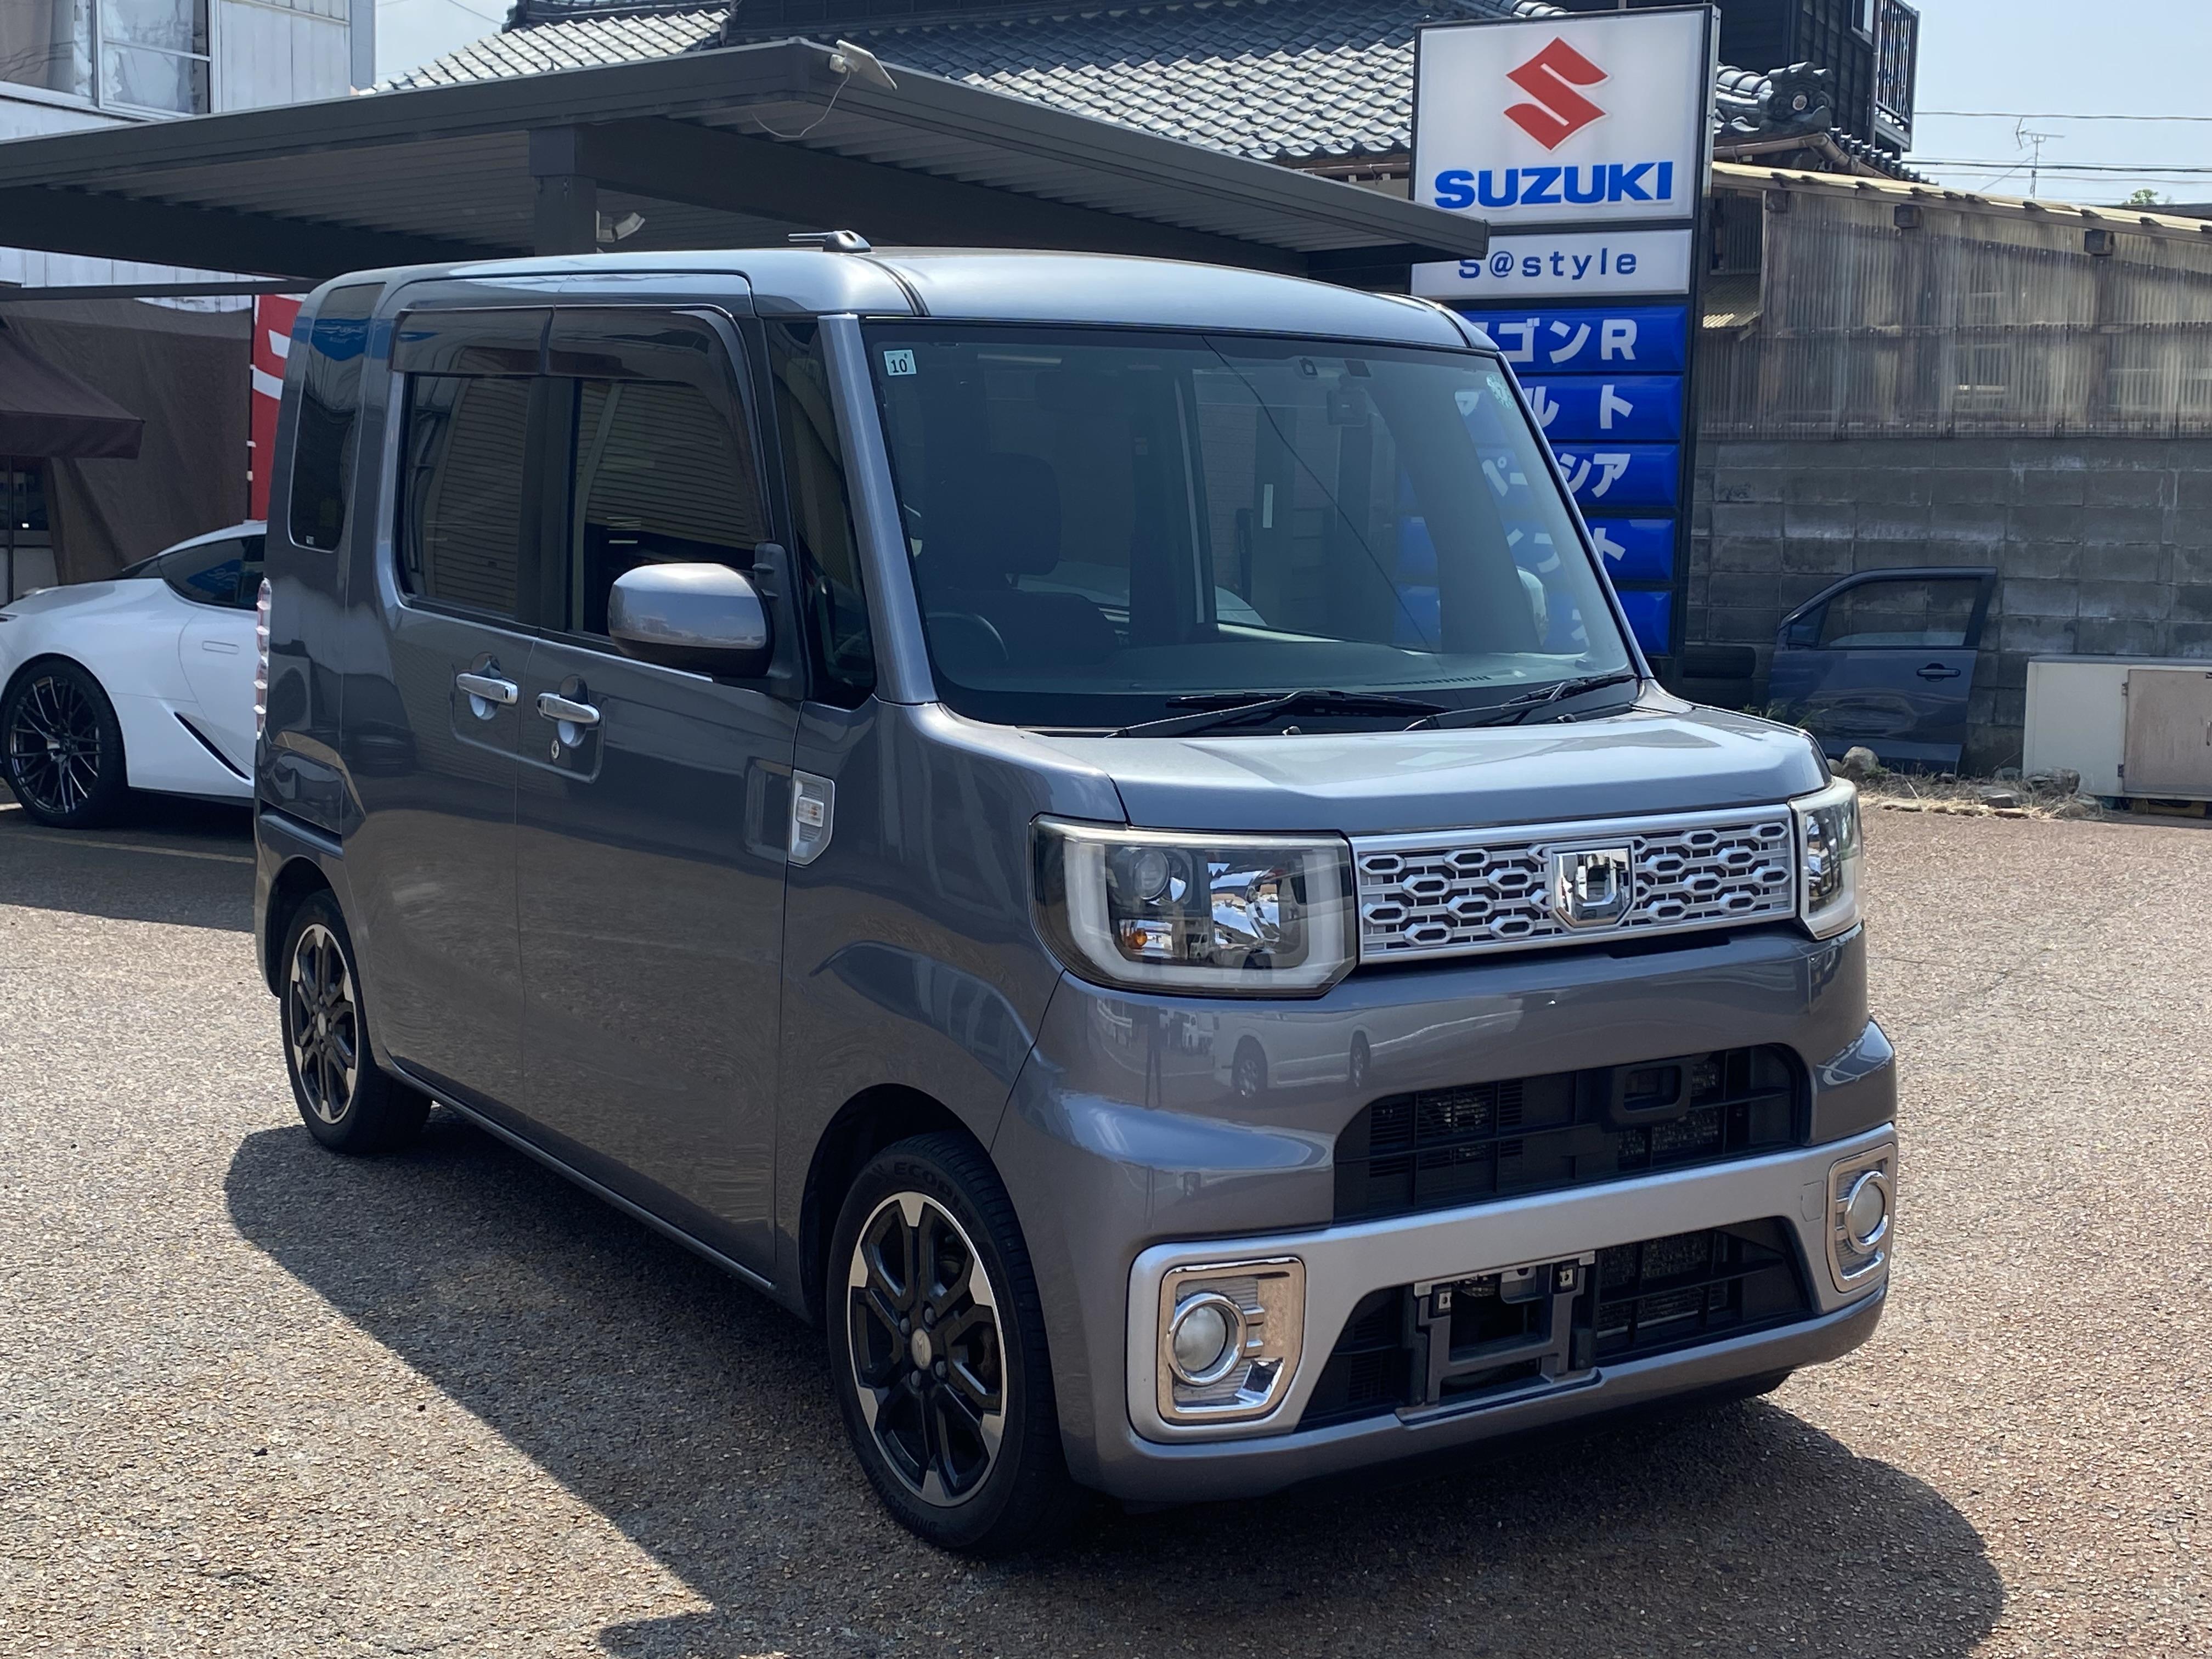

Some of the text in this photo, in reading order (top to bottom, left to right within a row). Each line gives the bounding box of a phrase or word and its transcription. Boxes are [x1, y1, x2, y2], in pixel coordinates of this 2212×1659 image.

[1435, 161, 1673, 209] SUZUKI
[1474, 317, 1637, 364] ゴンR
[891, 358, 907, 373] 10
